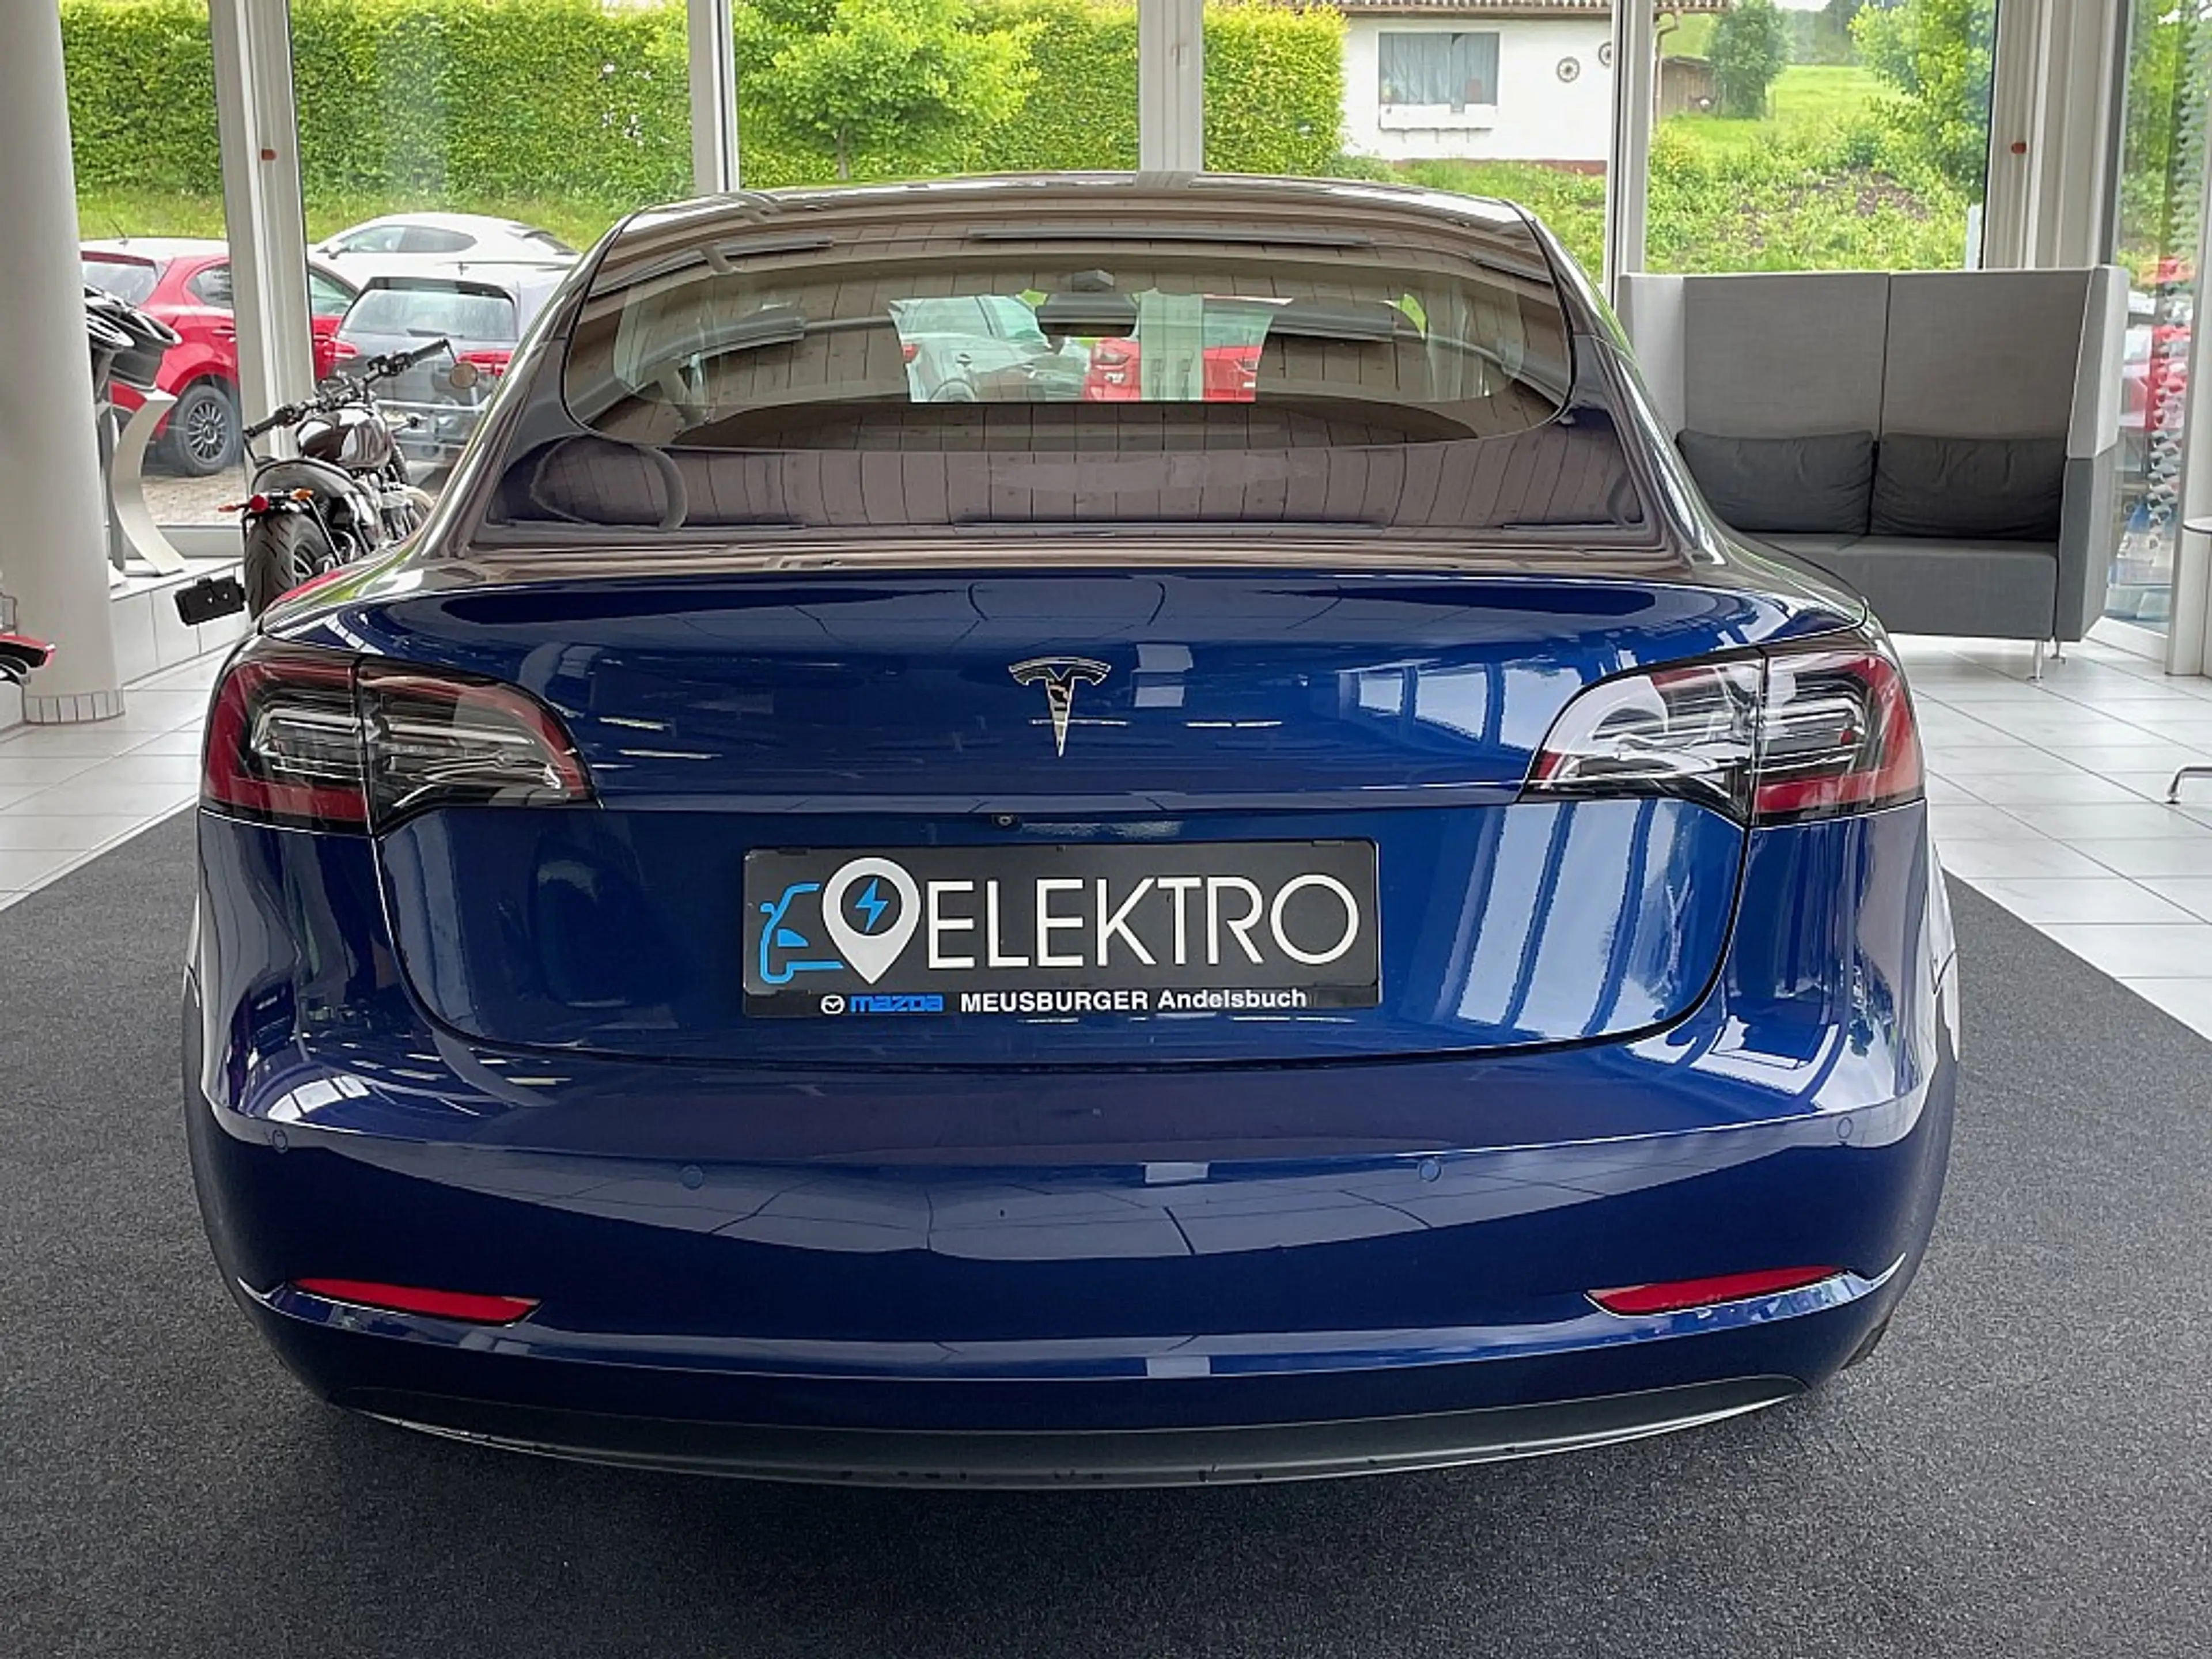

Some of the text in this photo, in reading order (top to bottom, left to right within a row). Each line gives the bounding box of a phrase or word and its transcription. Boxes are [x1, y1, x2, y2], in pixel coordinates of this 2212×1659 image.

[927, 874, 1359, 969] ELEKTRO
[849, 987, 1307, 1012] mazda MEUSBURGER Andelsbuch
